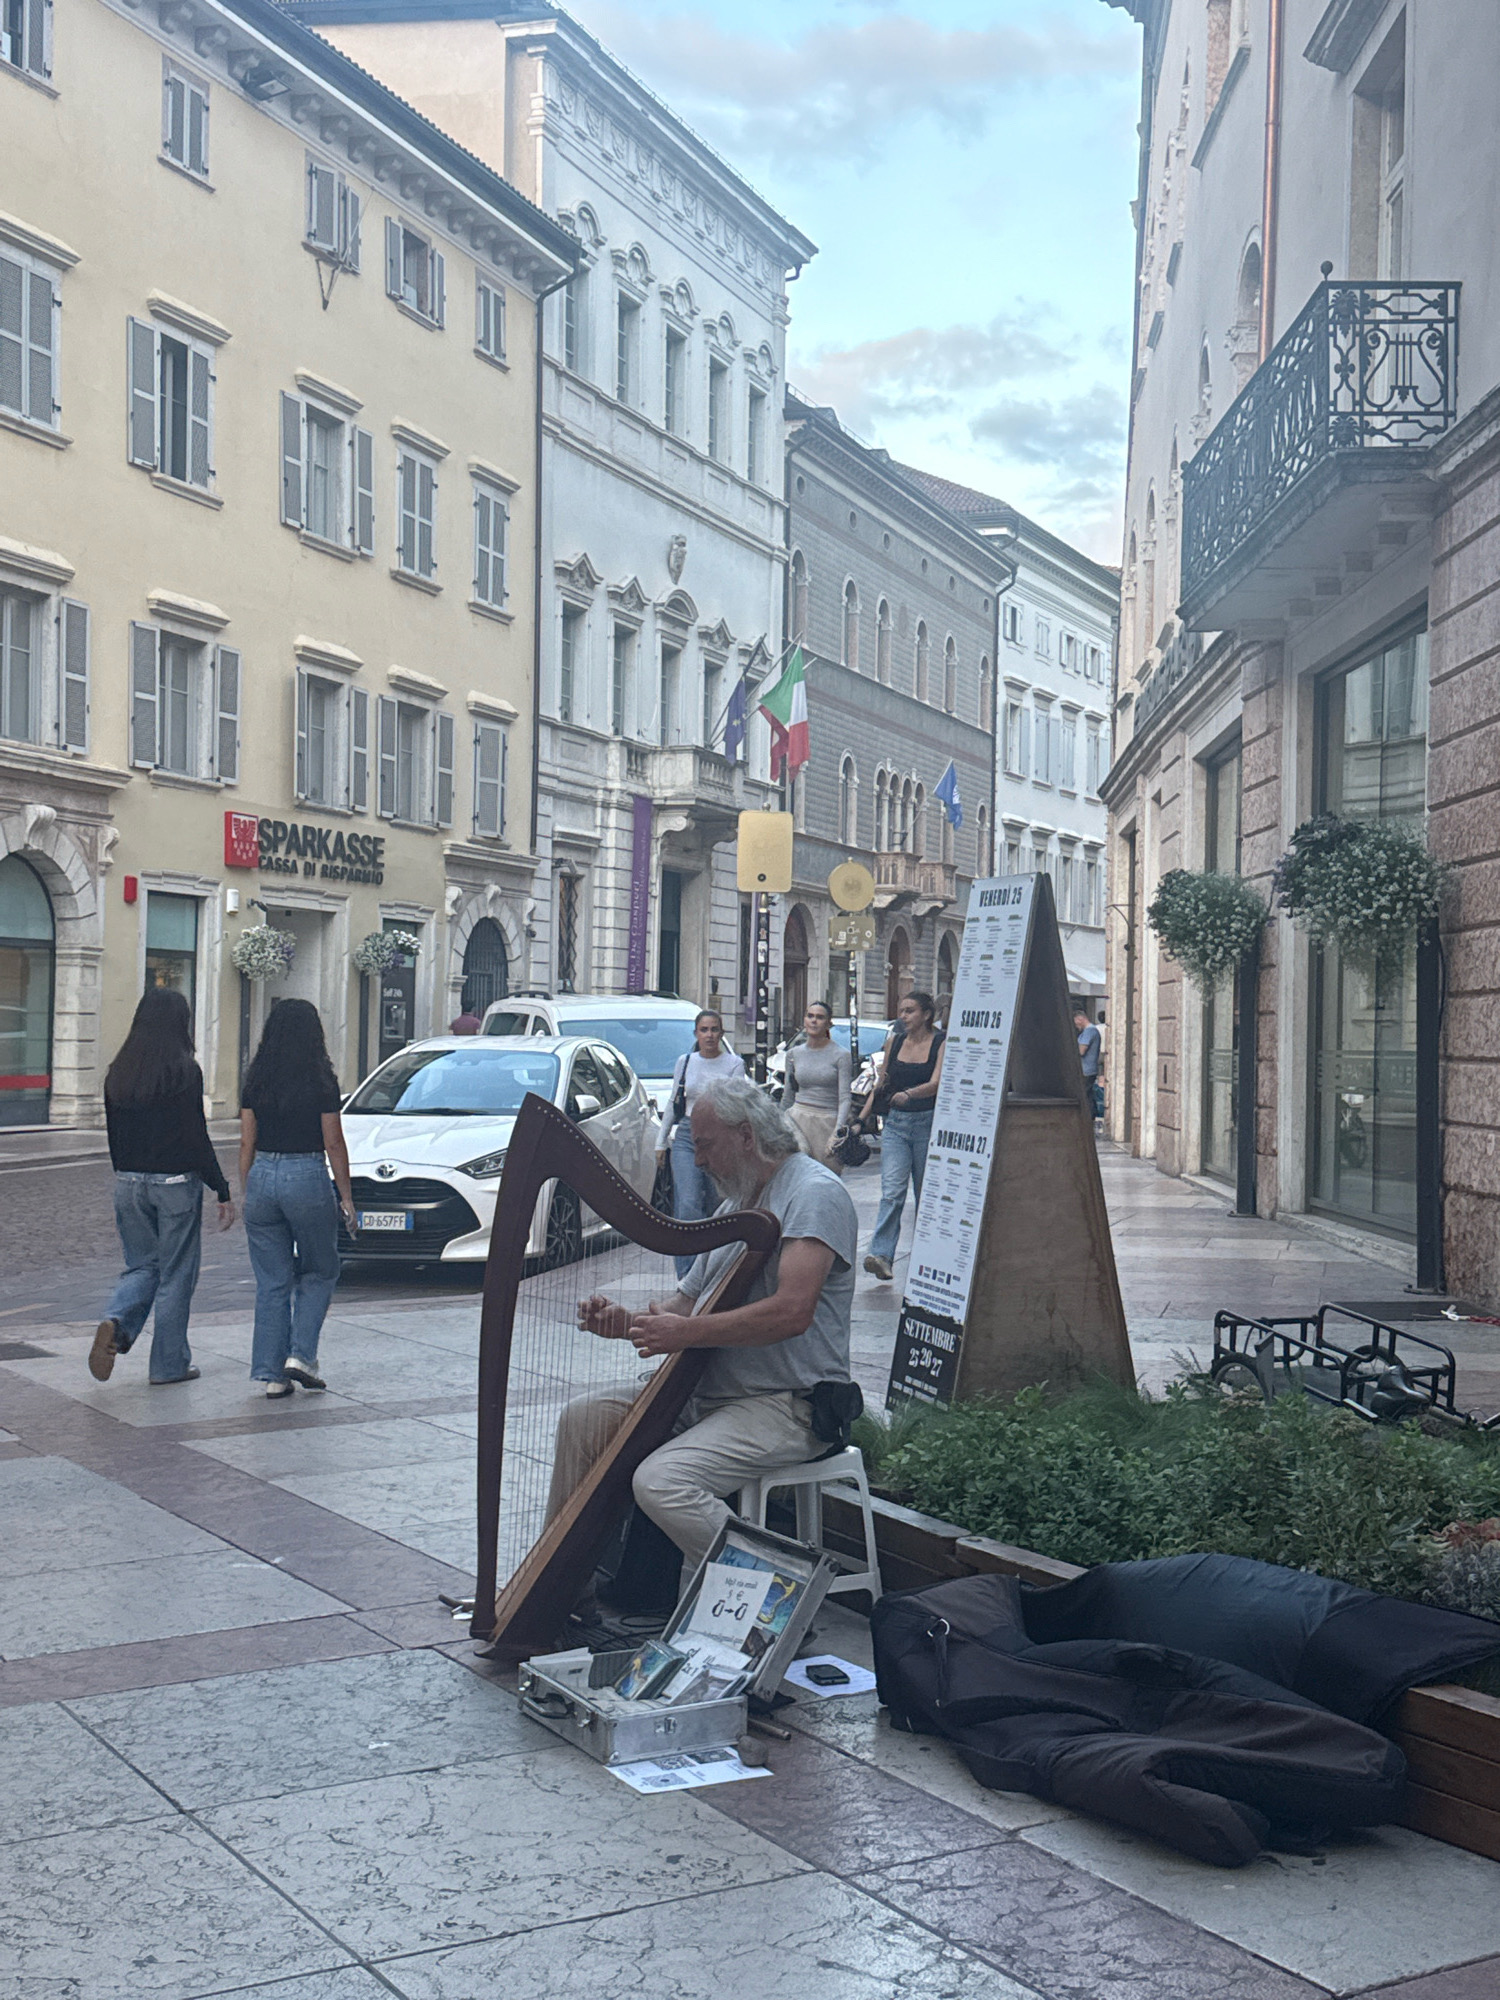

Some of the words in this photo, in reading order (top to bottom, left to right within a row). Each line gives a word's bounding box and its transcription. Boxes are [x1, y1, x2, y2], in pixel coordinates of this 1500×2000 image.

[258, 818, 385, 868] SPARKASSE
[258, 854, 299, 874] CASSA
[303, 861, 316, 877] DI
[320, 863, 384, 886] RISPARMIO
[979, 885, 1011, 907] VENERDÌ
[1011, 886, 1023, 905] 25
[961, 1009, 990, 1028] SABATO
[990, 1010, 1002, 1029] 26
[937, 1129, 975, 1153] DOMENICA
[976, 1135, 987, 1154] 27
[903, 1317, 956, 1353] SETTEMBRE
[908, 1347, 920, 1368] 25
[919, 1347, 933, 1368] 26
[930, 1357, 943, 1378] 27
